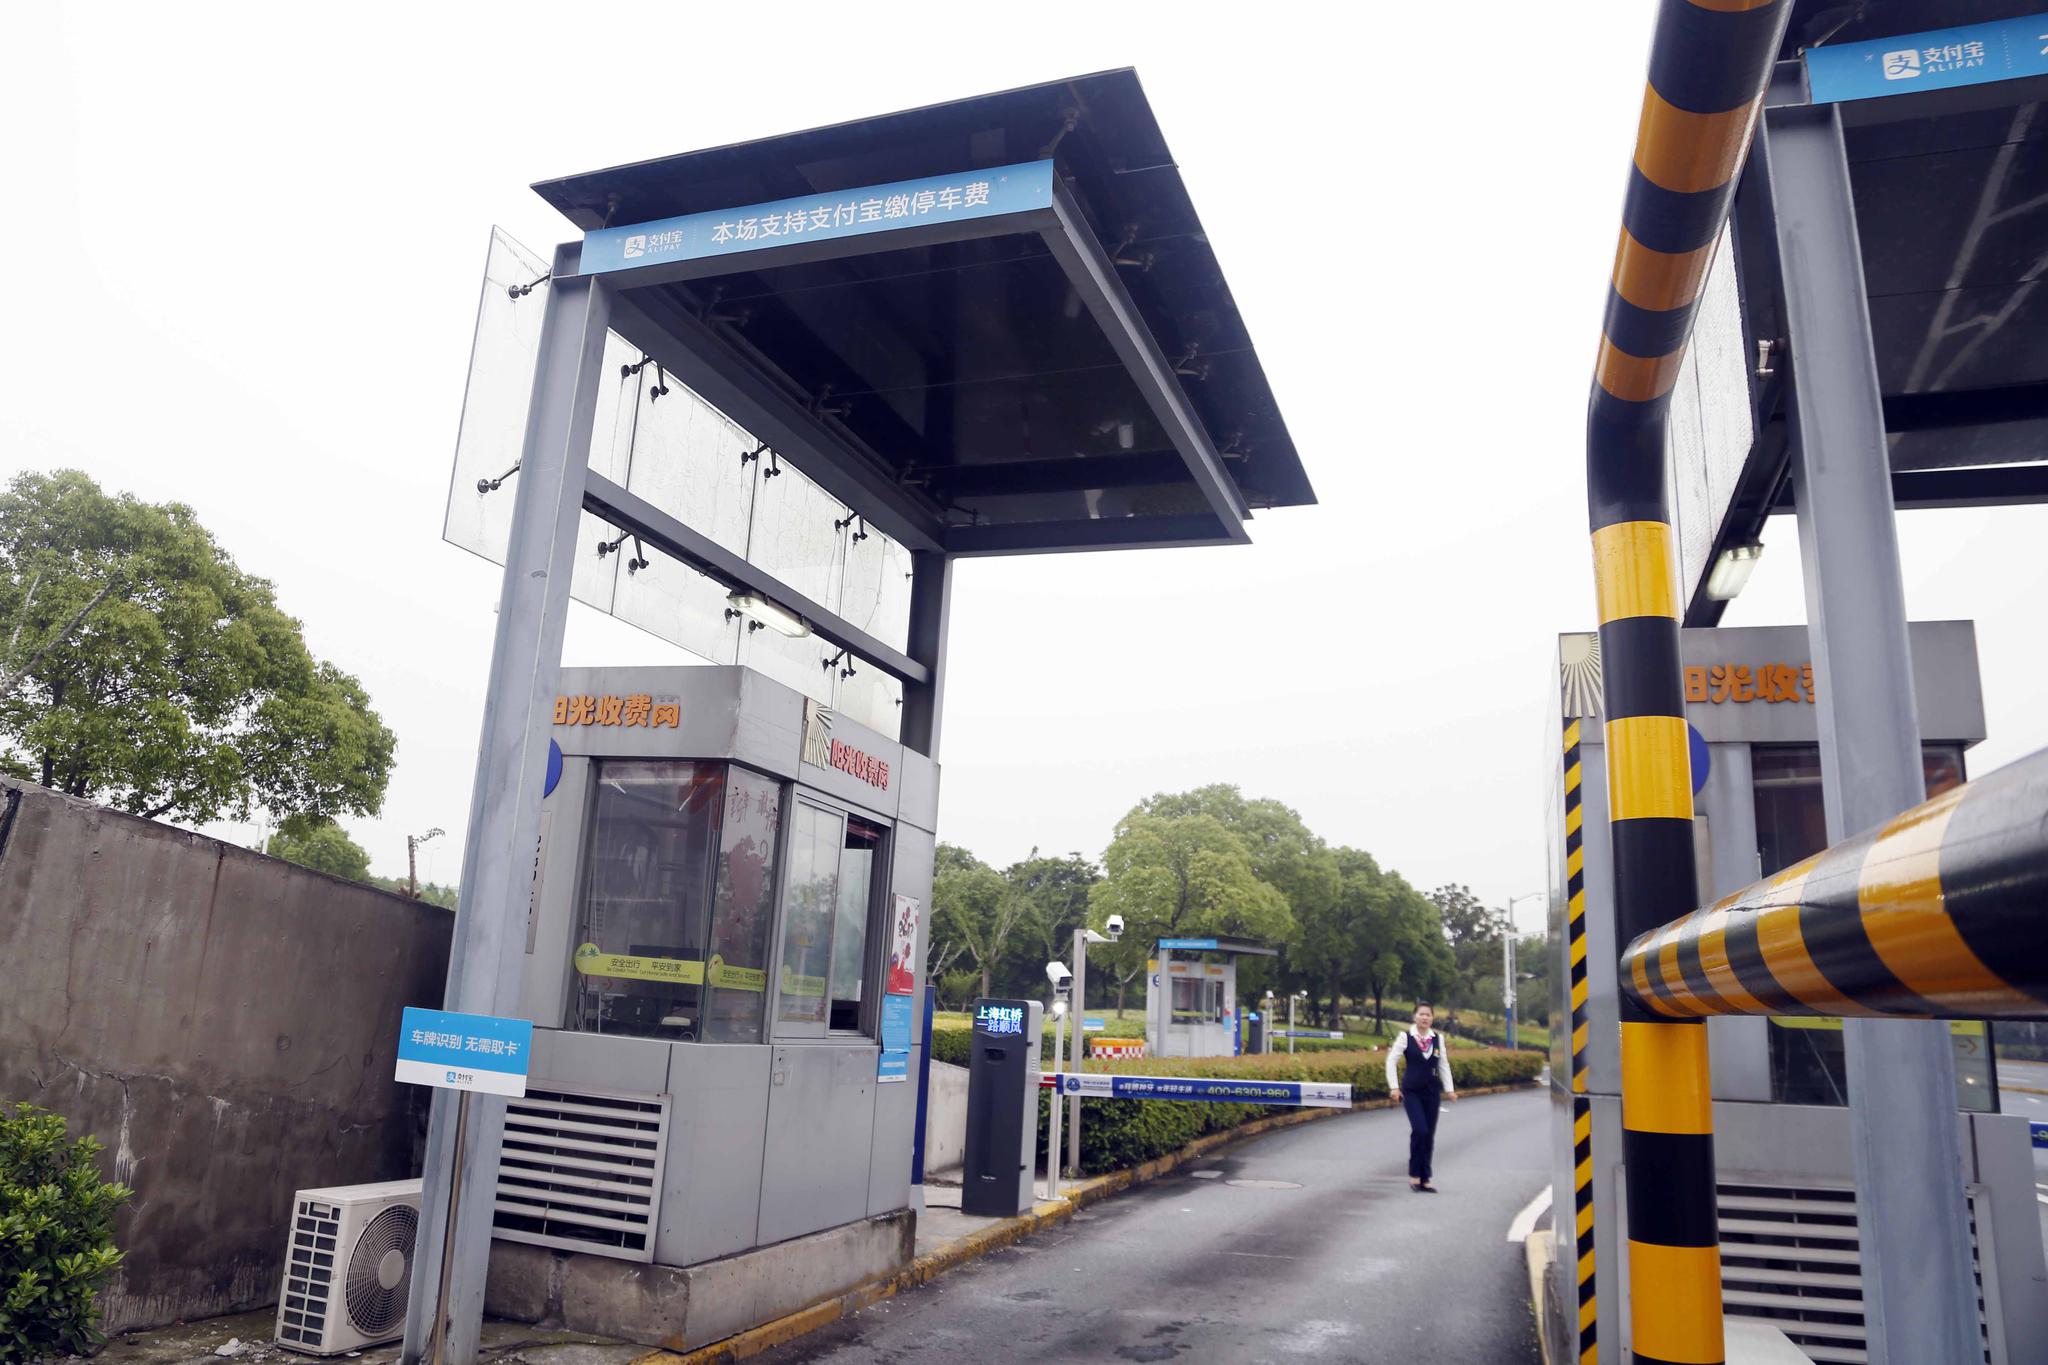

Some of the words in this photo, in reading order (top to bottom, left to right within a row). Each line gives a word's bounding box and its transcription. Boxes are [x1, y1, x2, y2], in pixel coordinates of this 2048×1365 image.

[1923, 41, 1985, 64] 支付宝
[1927, 58, 1984, 73] ALIPAY
[648, 230, 683, 248] 支付宝
[711, 181, 989, 245] 本场支持支付宝缴停车费
[648, 243, 681, 254] ALIPAY
[611, 958, 640, 969] 安全出行
[651, 961, 682, 972] 平安到家
[976, 1005, 1023, 1021] 上海虹桥
[976, 1020, 1021, 1034] 一路顺风
[411, 1029, 462, 1050] 车牌识别
[464, 1036, 518, 1057] 无需取卡
[1207, 1086, 1291, 1098] 400-6301-960
